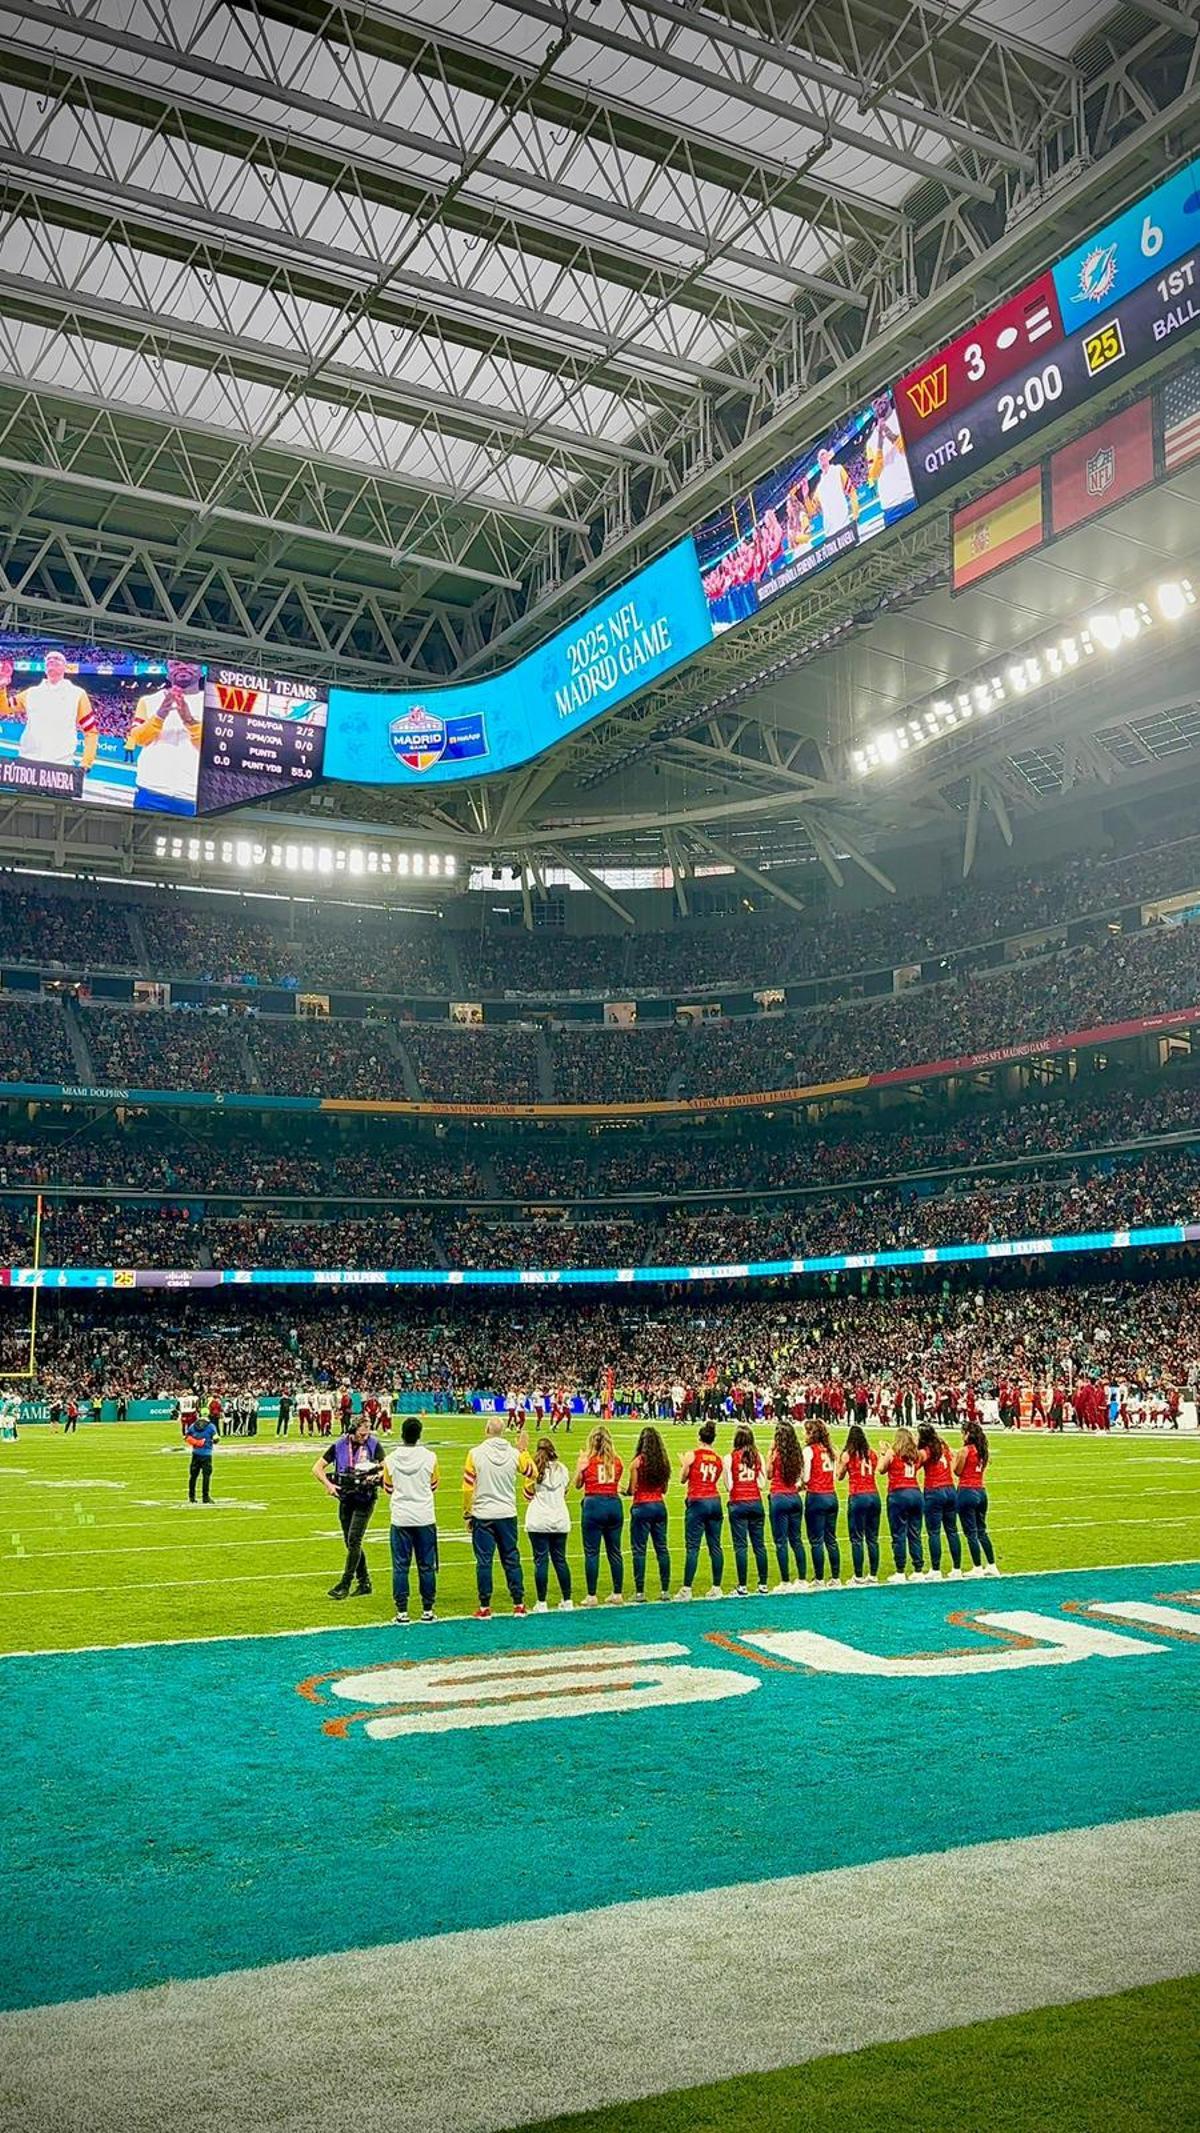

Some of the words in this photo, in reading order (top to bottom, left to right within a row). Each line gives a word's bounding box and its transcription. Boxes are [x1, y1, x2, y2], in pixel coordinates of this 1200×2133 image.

[1141, 215, 1163, 257] 6
[1157, 260, 1195, 302] 1ST
[1152, 300, 1200, 342] BALL
[964, 343, 986, 382] 3
[1086, 328, 1119, 369] 25
[997, 364, 1063, 433] 2:00
[924, 440, 958, 473] QTR
[957, 428, 974, 455] 2
[566, 623, 608, 676] 2025
[608, 601, 643, 647] NFL
[554, 655, 618, 719] MADRID
[618, 616, 672, 675] GAME
[219, 670, 271, 692] SPECIAL
[274, 681, 318, 700] TEAMS
[214, 726, 234, 738] 0/0
[295, 740, 313, 751] 0/0
[217, 712, 234, 724] 1/2
[296, 726, 314, 737] 2/2
[393, 733, 442, 745] MADRID
[213, 755, 230, 766] 0.0
[241, 760, 265, 771] PUNT
[265, 763, 282, 773] YDS
[291, 767, 312, 779] 55.0
[219, 742, 226, 751] 0
[249, 747, 277, 759] PUNTS
[301, 755, 306, 764] 1
[4, 761, 38, 786] FÚTBOL
[62, 1087, 87, 1097] MIAMI
[114, 1271, 134, 1286] 25
[700, 1462, 718, 1482] 44
